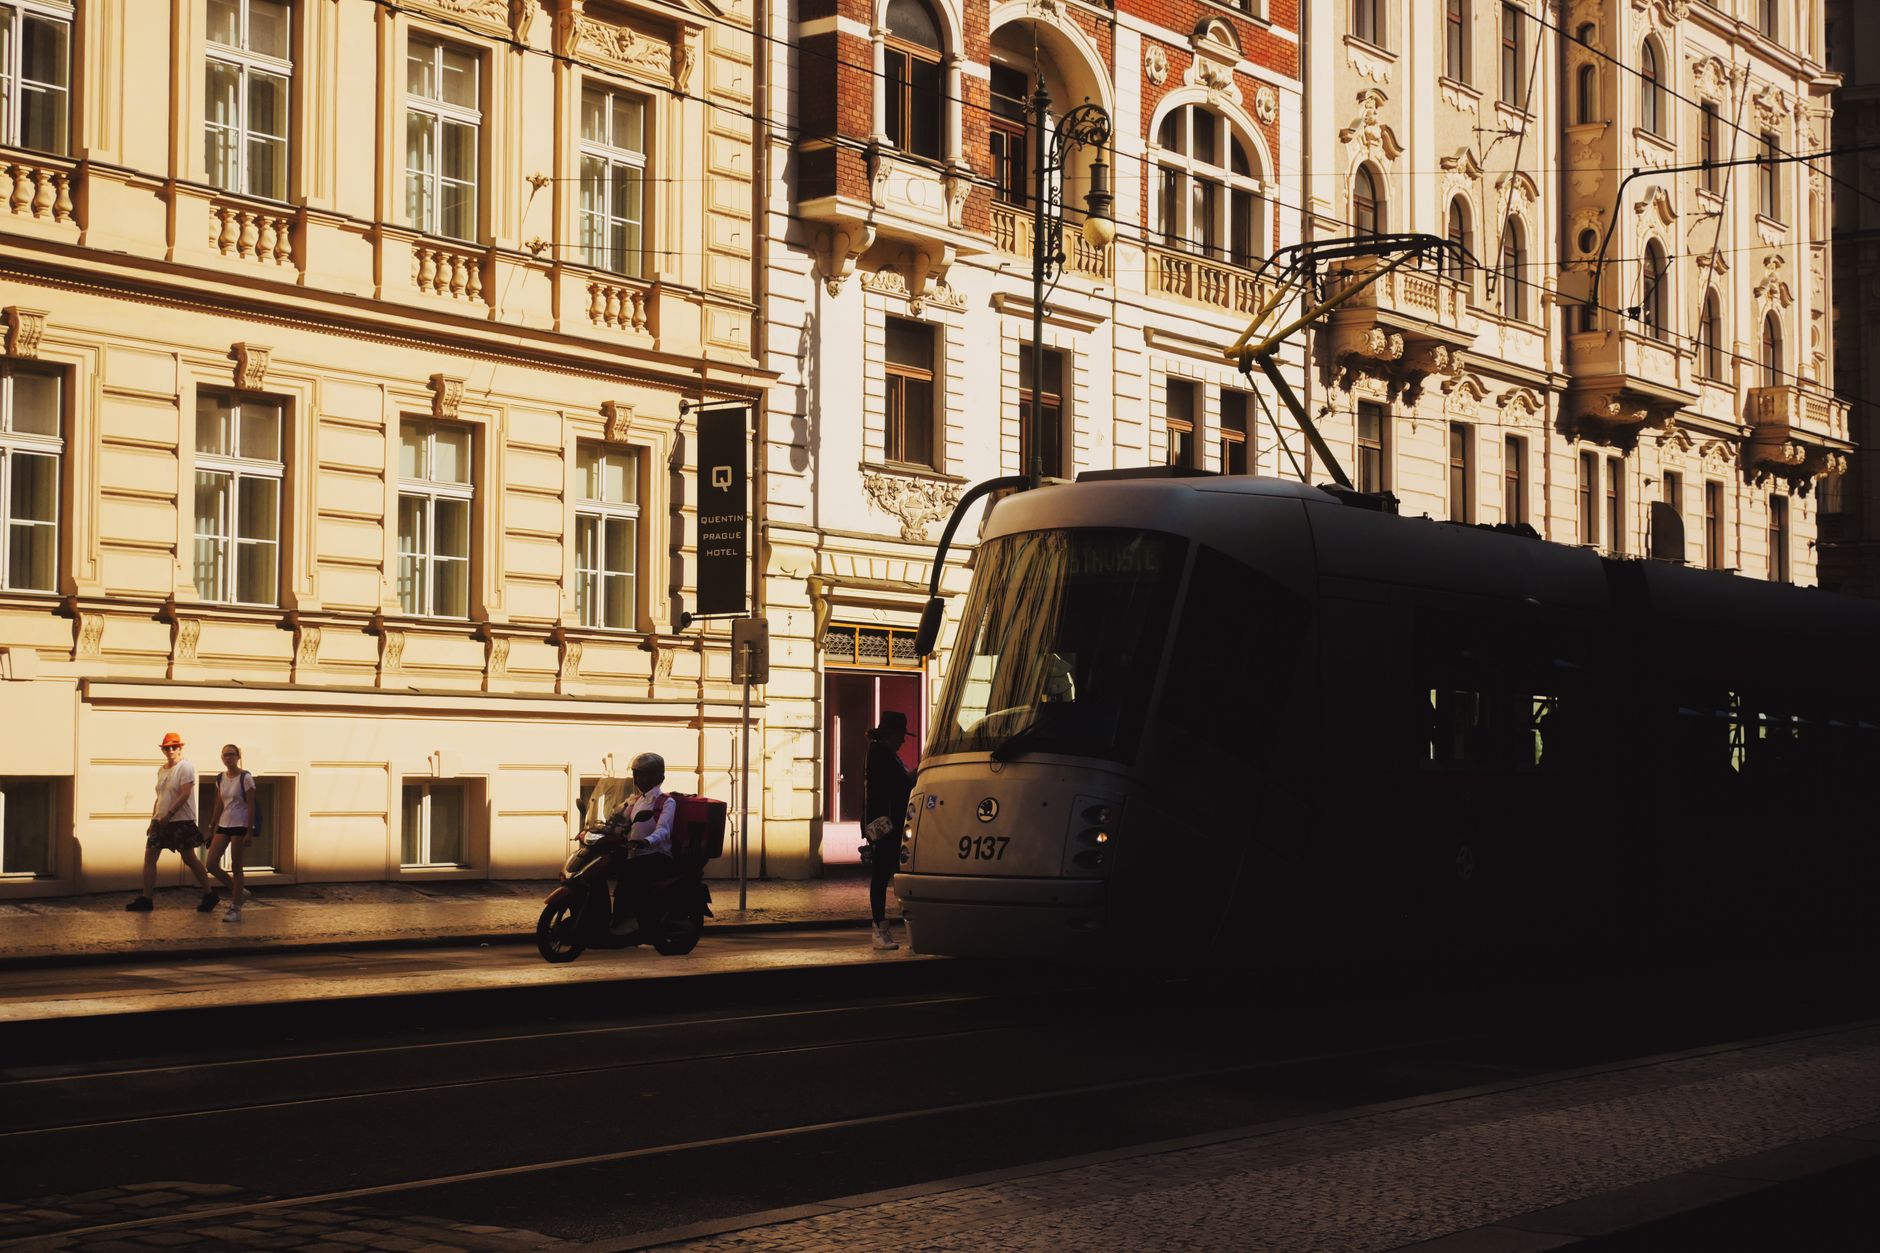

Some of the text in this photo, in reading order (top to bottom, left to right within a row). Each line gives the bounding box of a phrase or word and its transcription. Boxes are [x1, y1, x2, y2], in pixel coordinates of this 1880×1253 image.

[712, 465, 732, 492] Q
[701, 515, 744, 524] QUENTIN
[703, 532, 742, 541] PRAGUE
[706, 548, 738, 557] HOTEL
[958, 835, 1010, 860] 9137
